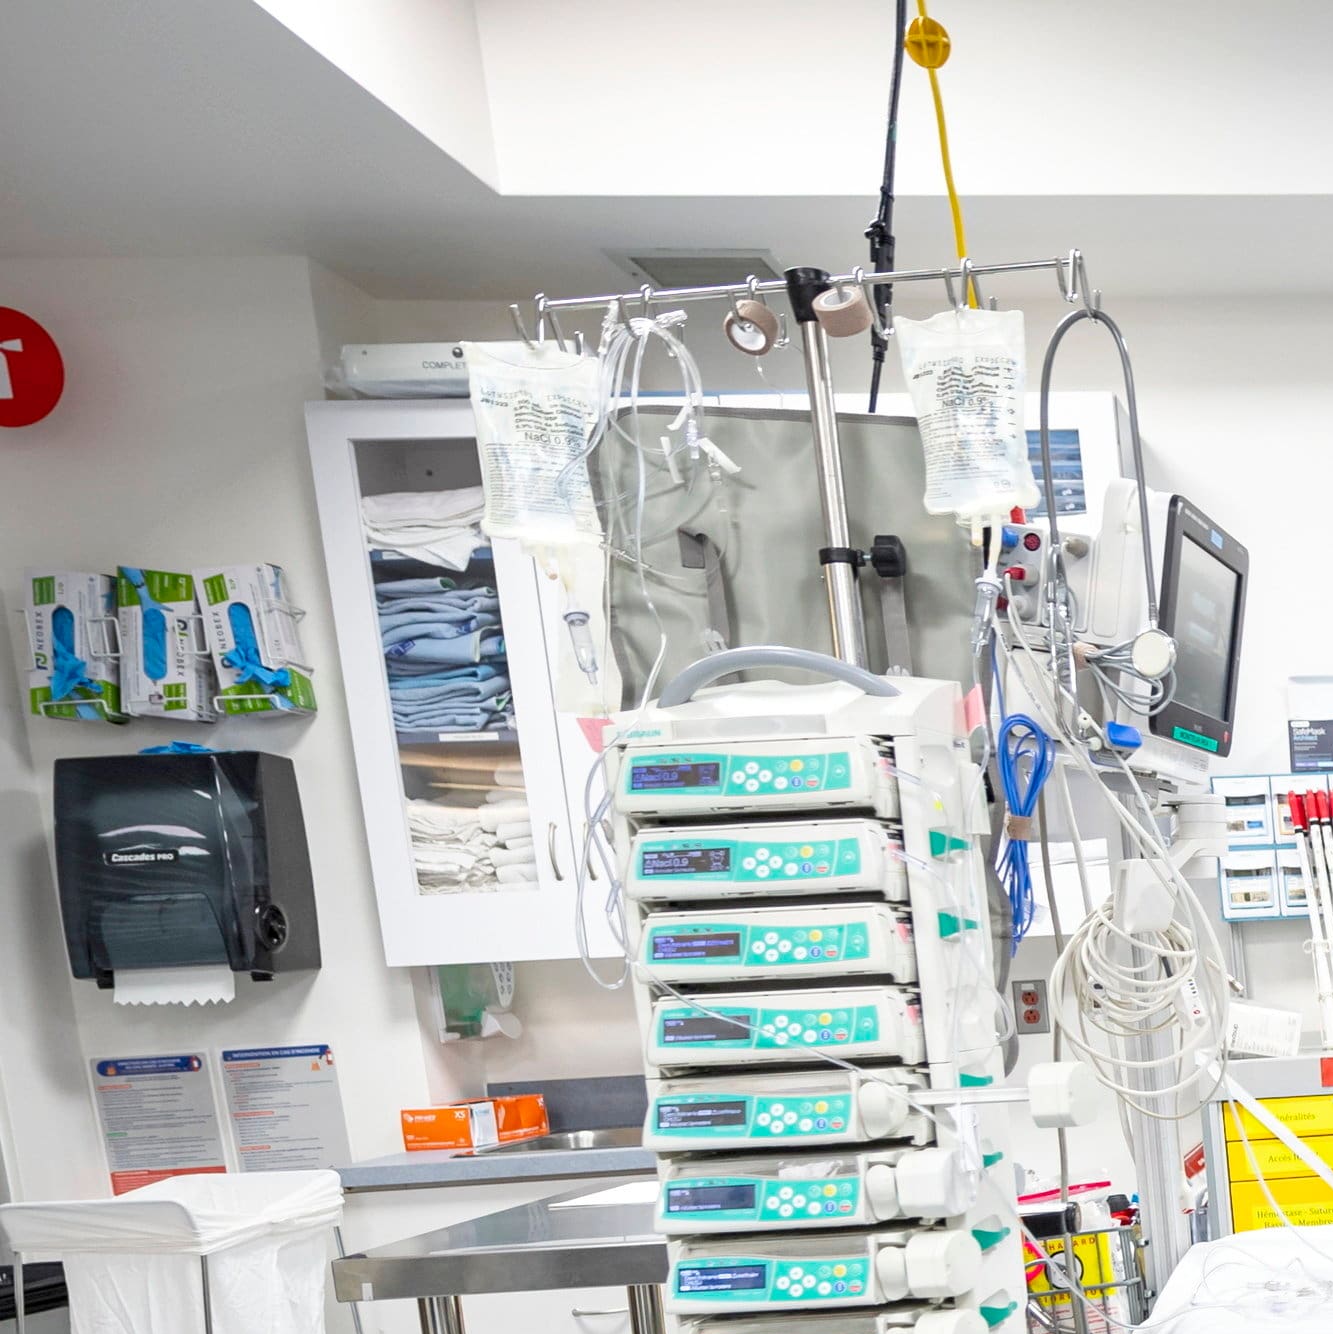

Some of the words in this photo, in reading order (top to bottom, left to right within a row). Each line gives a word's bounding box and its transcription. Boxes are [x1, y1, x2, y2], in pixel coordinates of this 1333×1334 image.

[525, 431, 551, 445] NaCl
[34, 611, 44, 650] NEOBEX
[212, 611, 227, 652] NEOBEX
[111, 852, 156, 863] Cascades
[156, 852, 174, 861] PRO
[1277, 1112, 1316, 1122] néralités
[1268, 1154, 1291, 1163] Accès
[1256, 1208, 1303, 1219] Hémtase
